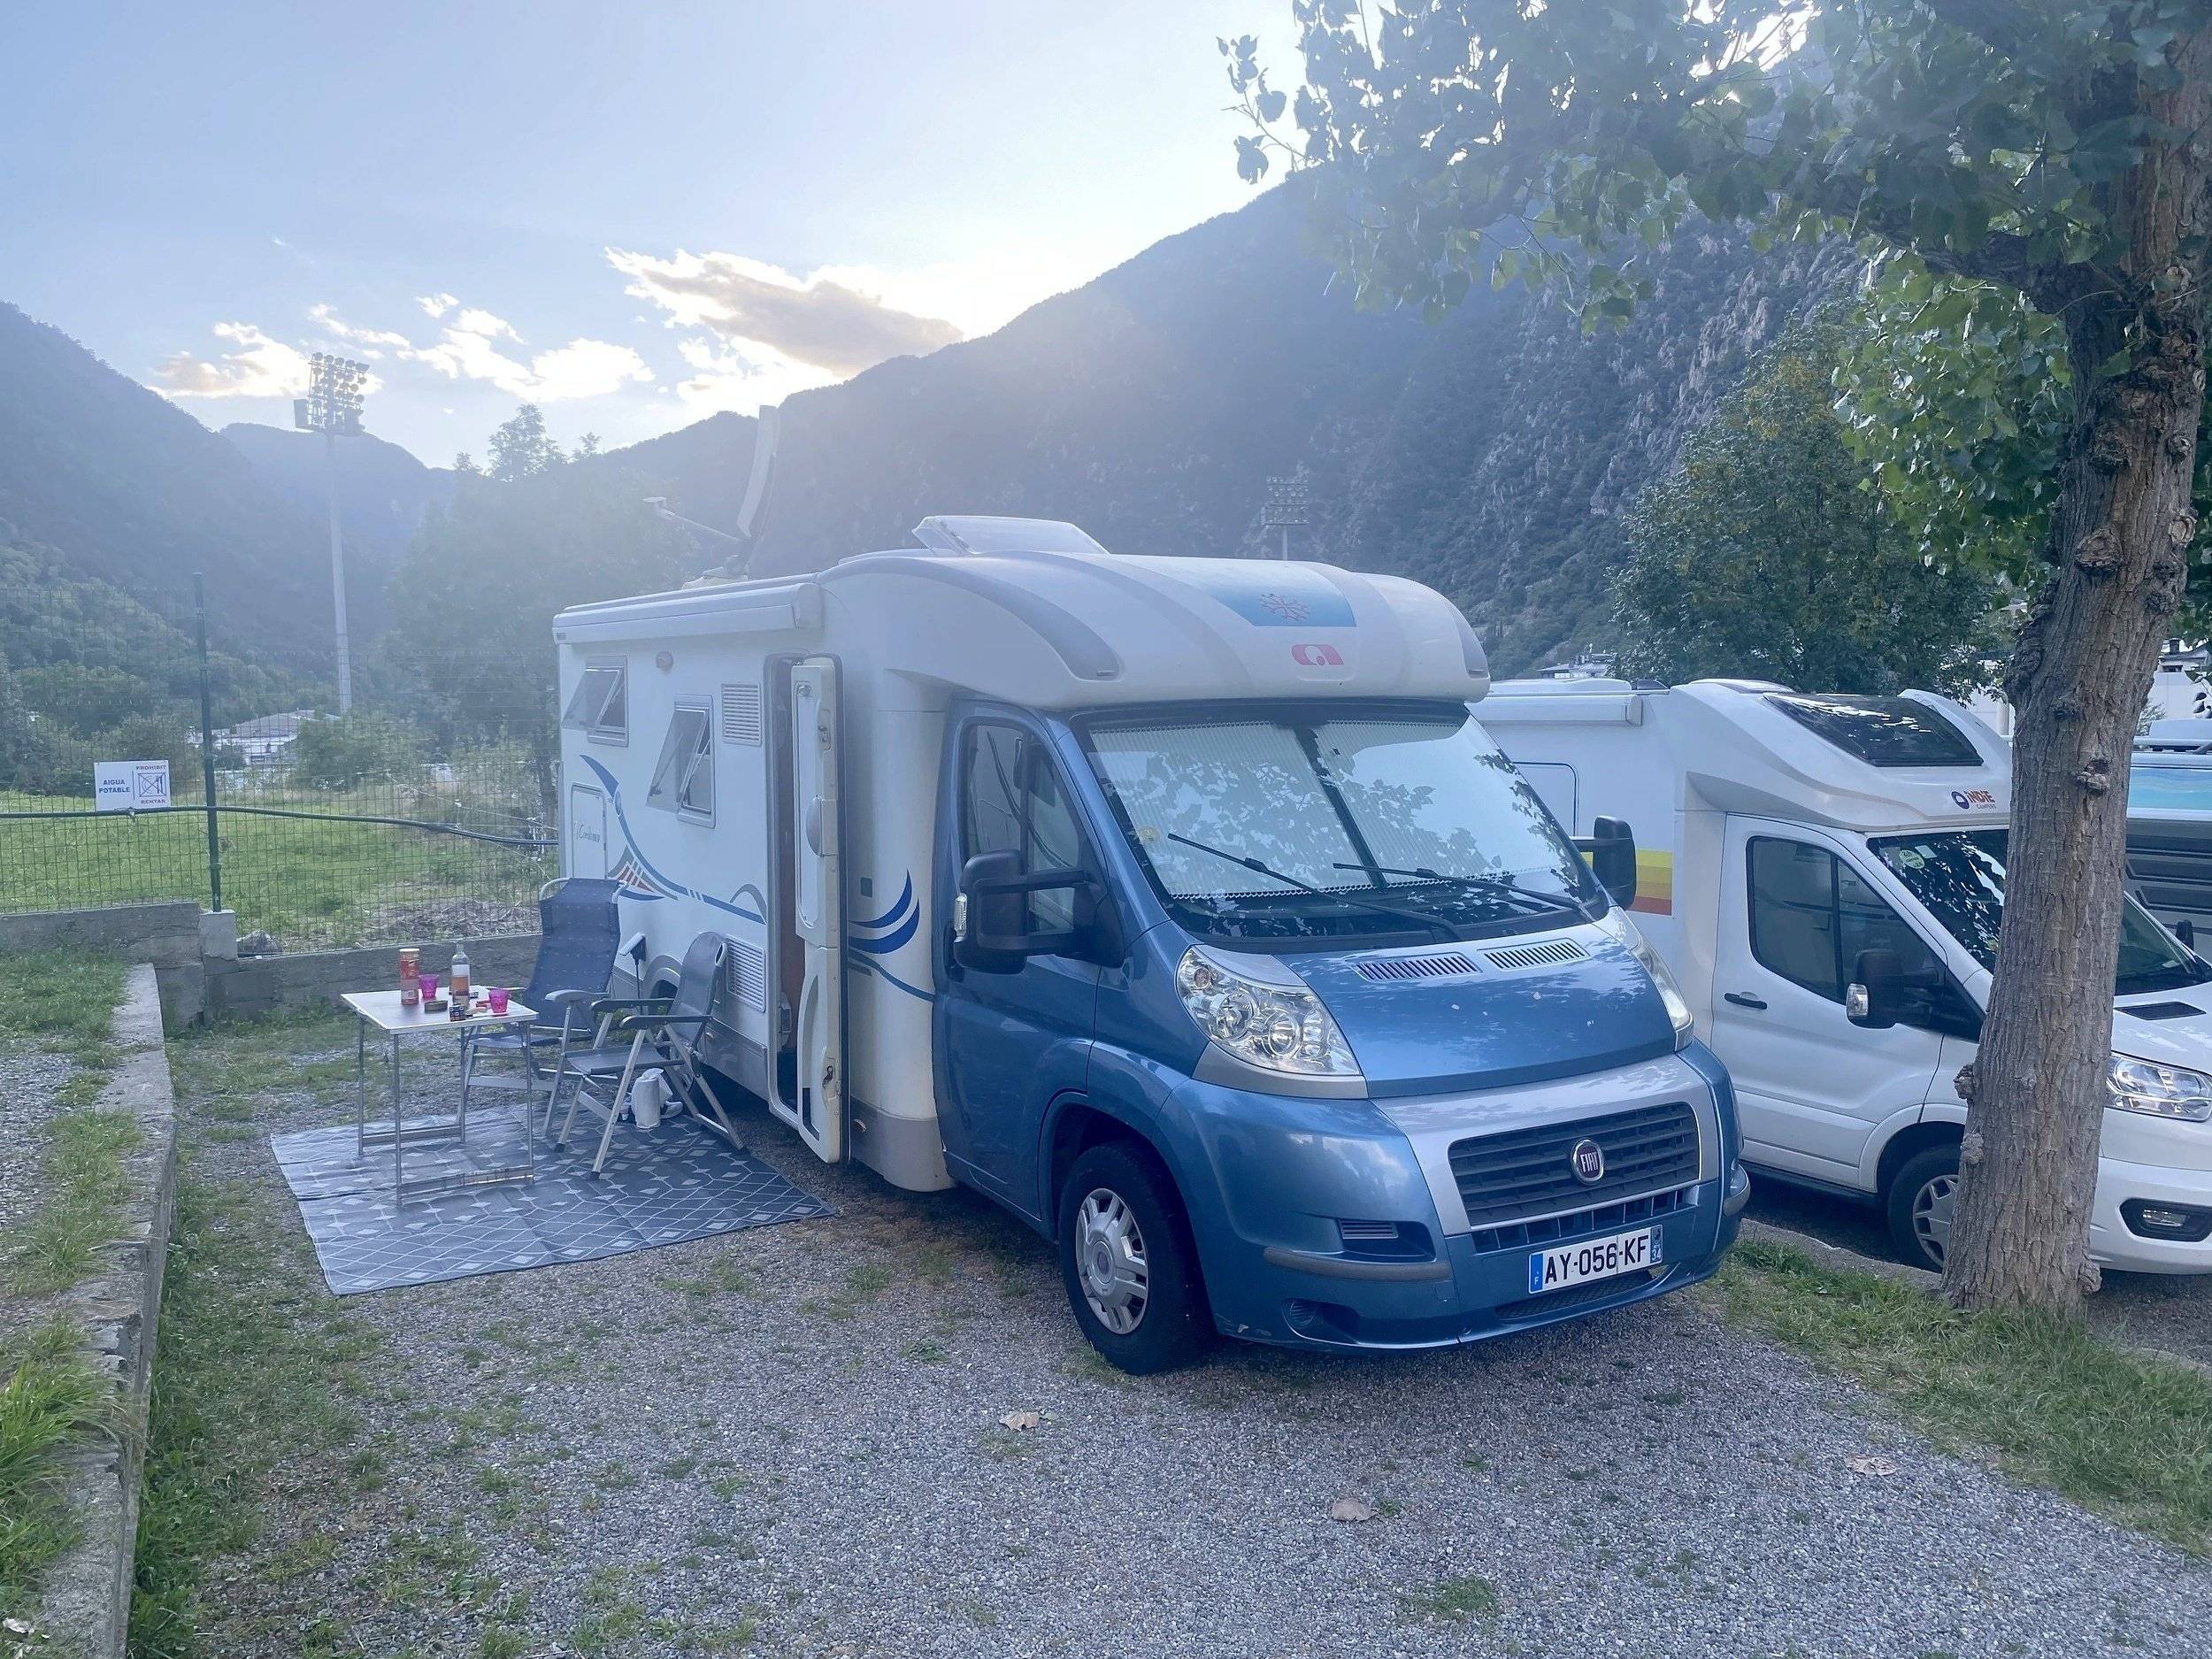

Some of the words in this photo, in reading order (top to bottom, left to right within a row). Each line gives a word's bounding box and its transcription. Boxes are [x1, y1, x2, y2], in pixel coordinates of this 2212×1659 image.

[1579, 1151, 1600, 1173] FIAT
[1544, 1234, 1649, 1285] AY-056-KF
[1533, 1276, 1539, 1286] F
